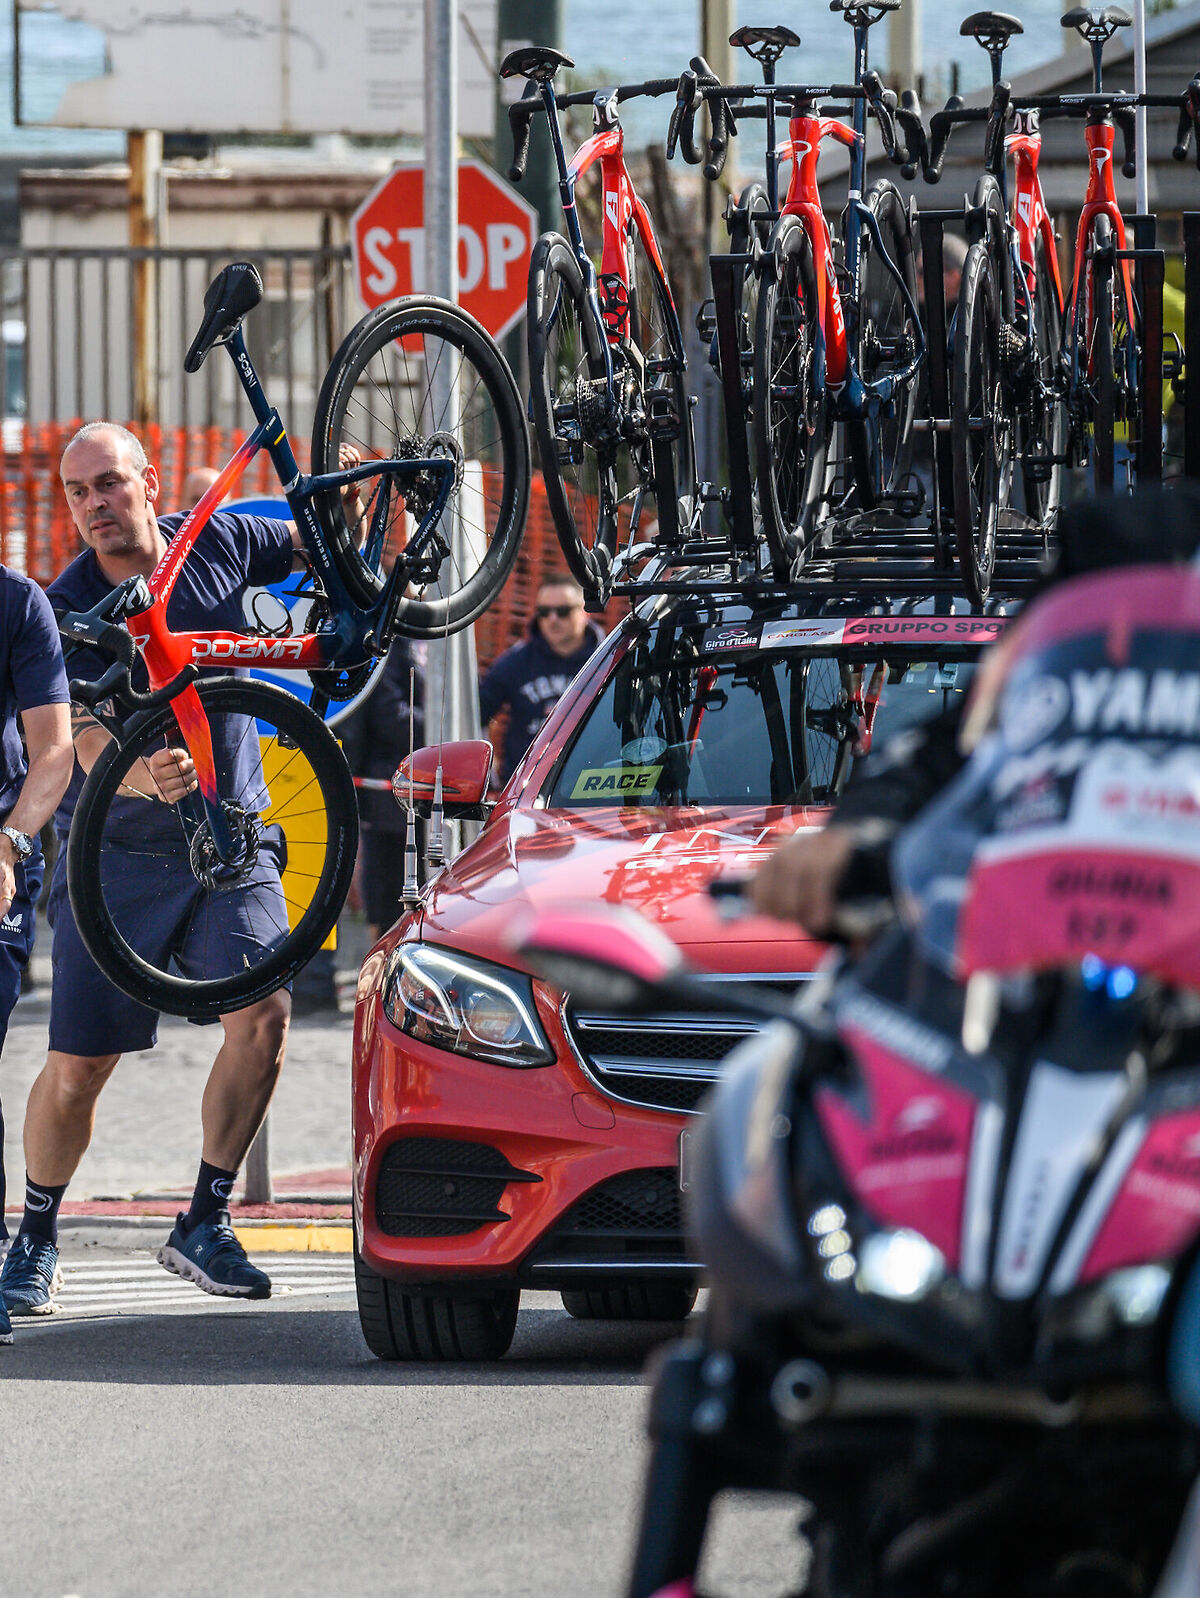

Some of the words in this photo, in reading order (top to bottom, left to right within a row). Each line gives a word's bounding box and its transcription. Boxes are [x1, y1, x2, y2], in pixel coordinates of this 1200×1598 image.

[363, 224, 526, 296] STOP
[238, 352, 257, 388] INEOS
[303, 507, 330, 568] GRENADIER
[160, 539, 192, 604] PINARELLO
[110, 590, 128, 618] MOST
[767, 630, 835, 639] CARGLASS
[850, 622, 948, 634] GRUPPO
[954, 621, 1012, 633] SPO
[191, 638, 303, 660] DOGMA
[705, 640, 725, 649] Giro
[582, 773, 651, 791] RACE
